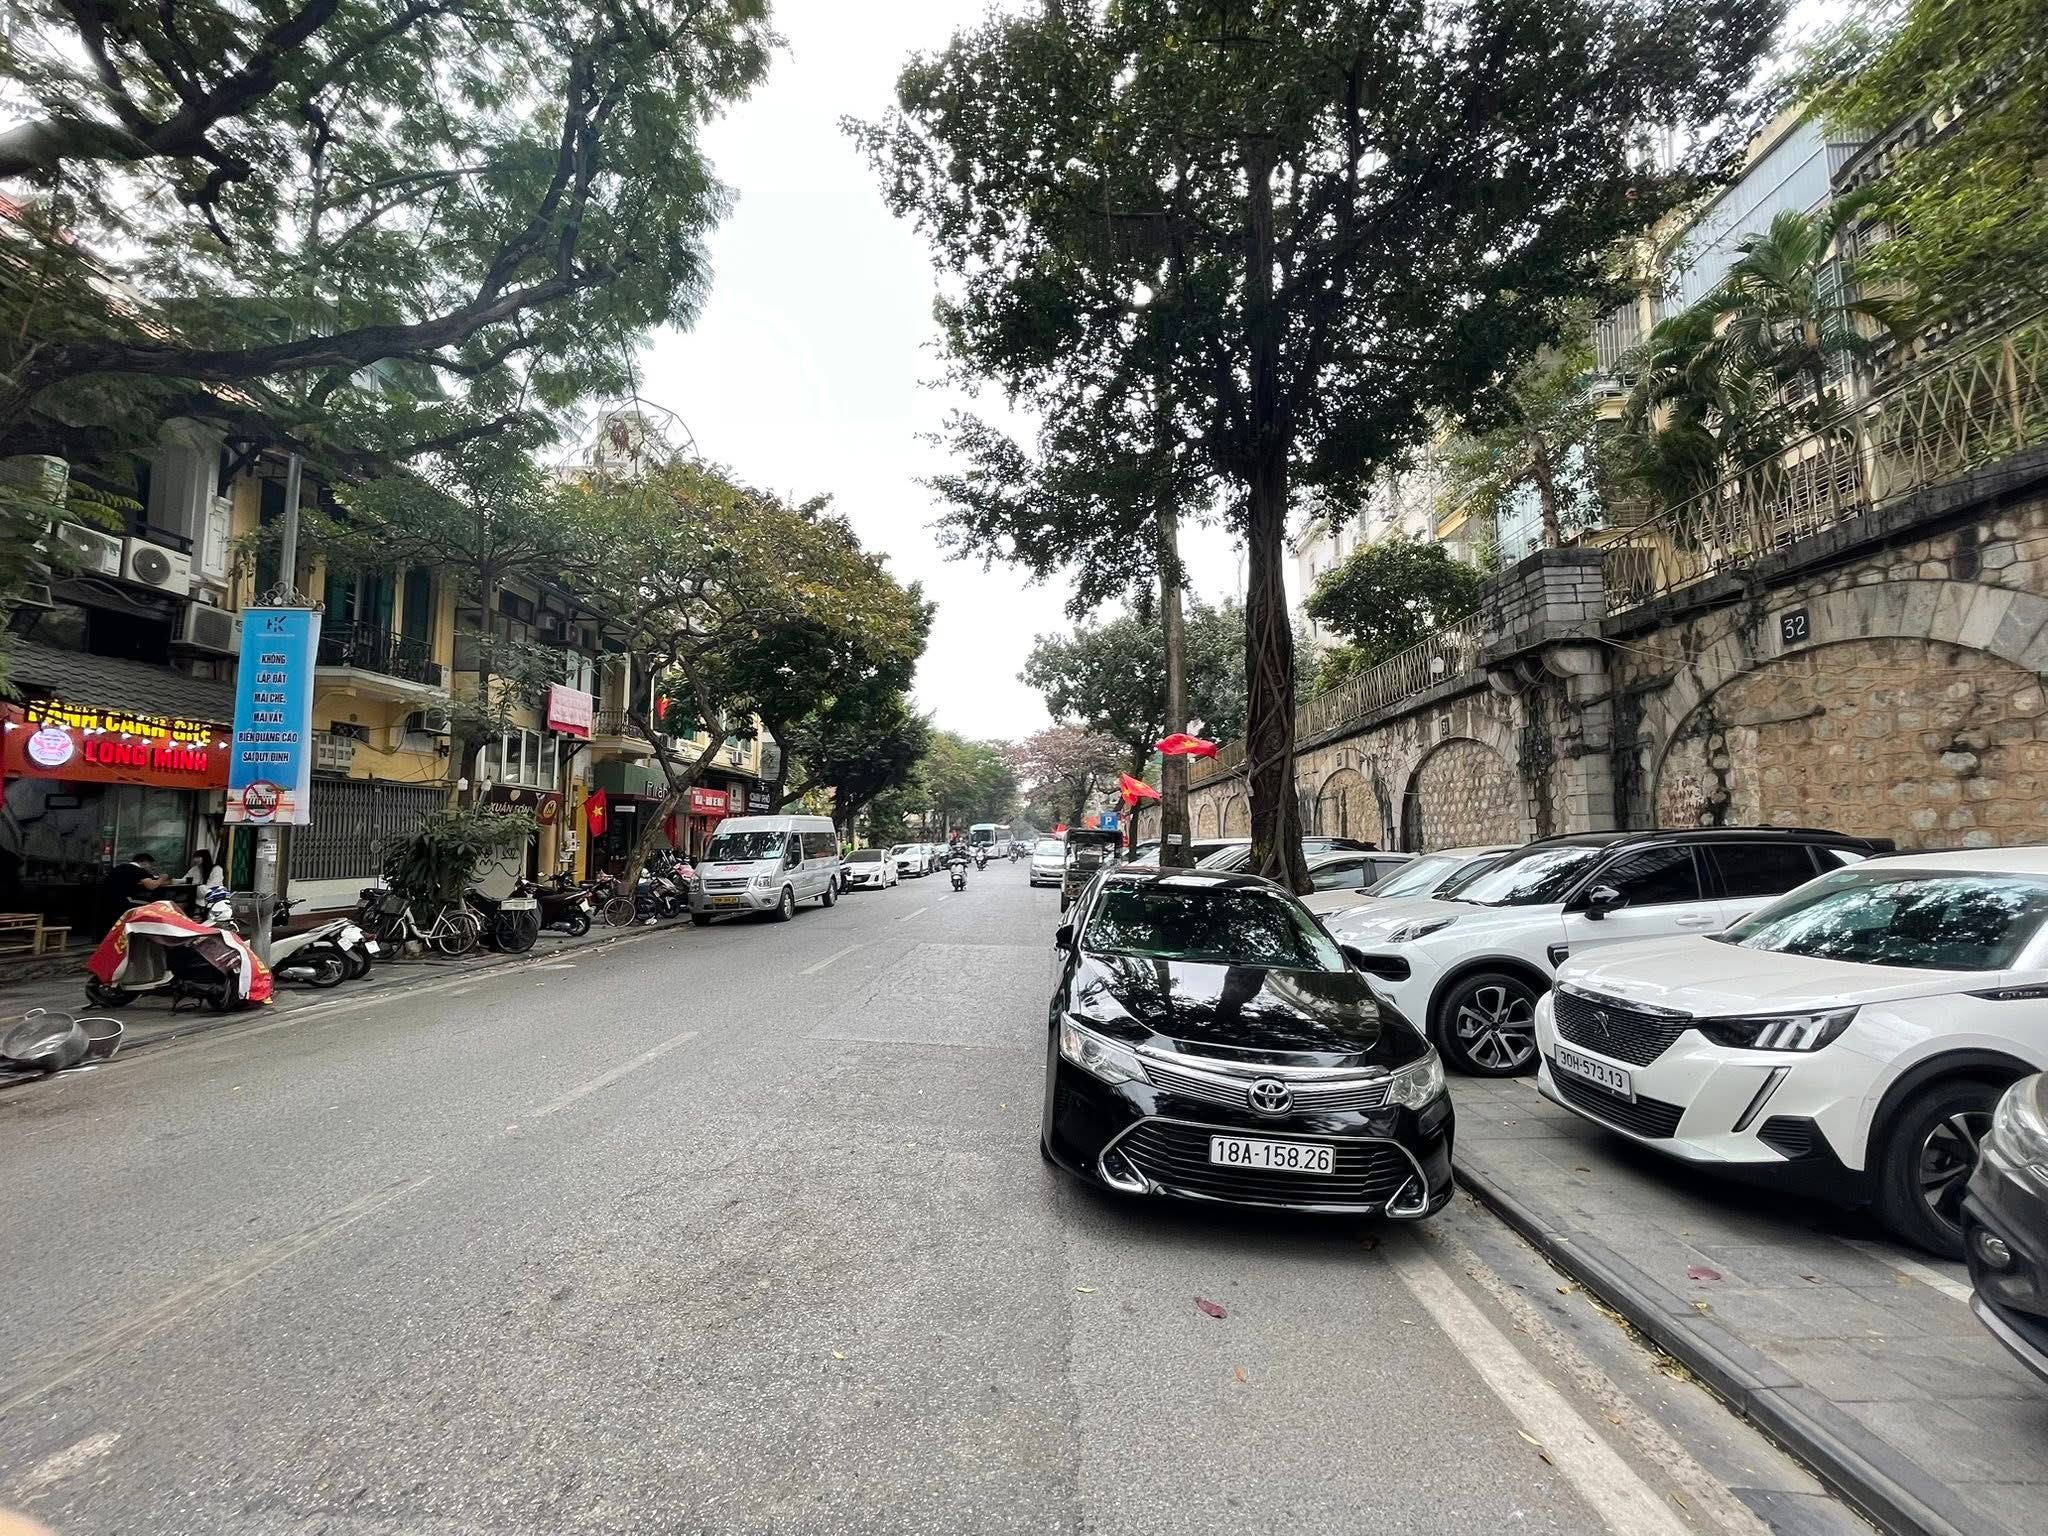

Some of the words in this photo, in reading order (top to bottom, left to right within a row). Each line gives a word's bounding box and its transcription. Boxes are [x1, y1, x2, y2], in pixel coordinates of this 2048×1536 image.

[1784, 615, 1806, 639] 32
[261, 652, 287, 664] KHÔNG
[84, 740, 147, 767] LONG
[152, 747, 209, 771] MINH
[243, 752, 255, 762] SAI
[1105, 816, 1112, 826] P
[1560, 1051, 1623, 1088] 30H-573.13
[1217, 1141, 1329, 1170] 18A-158.26
